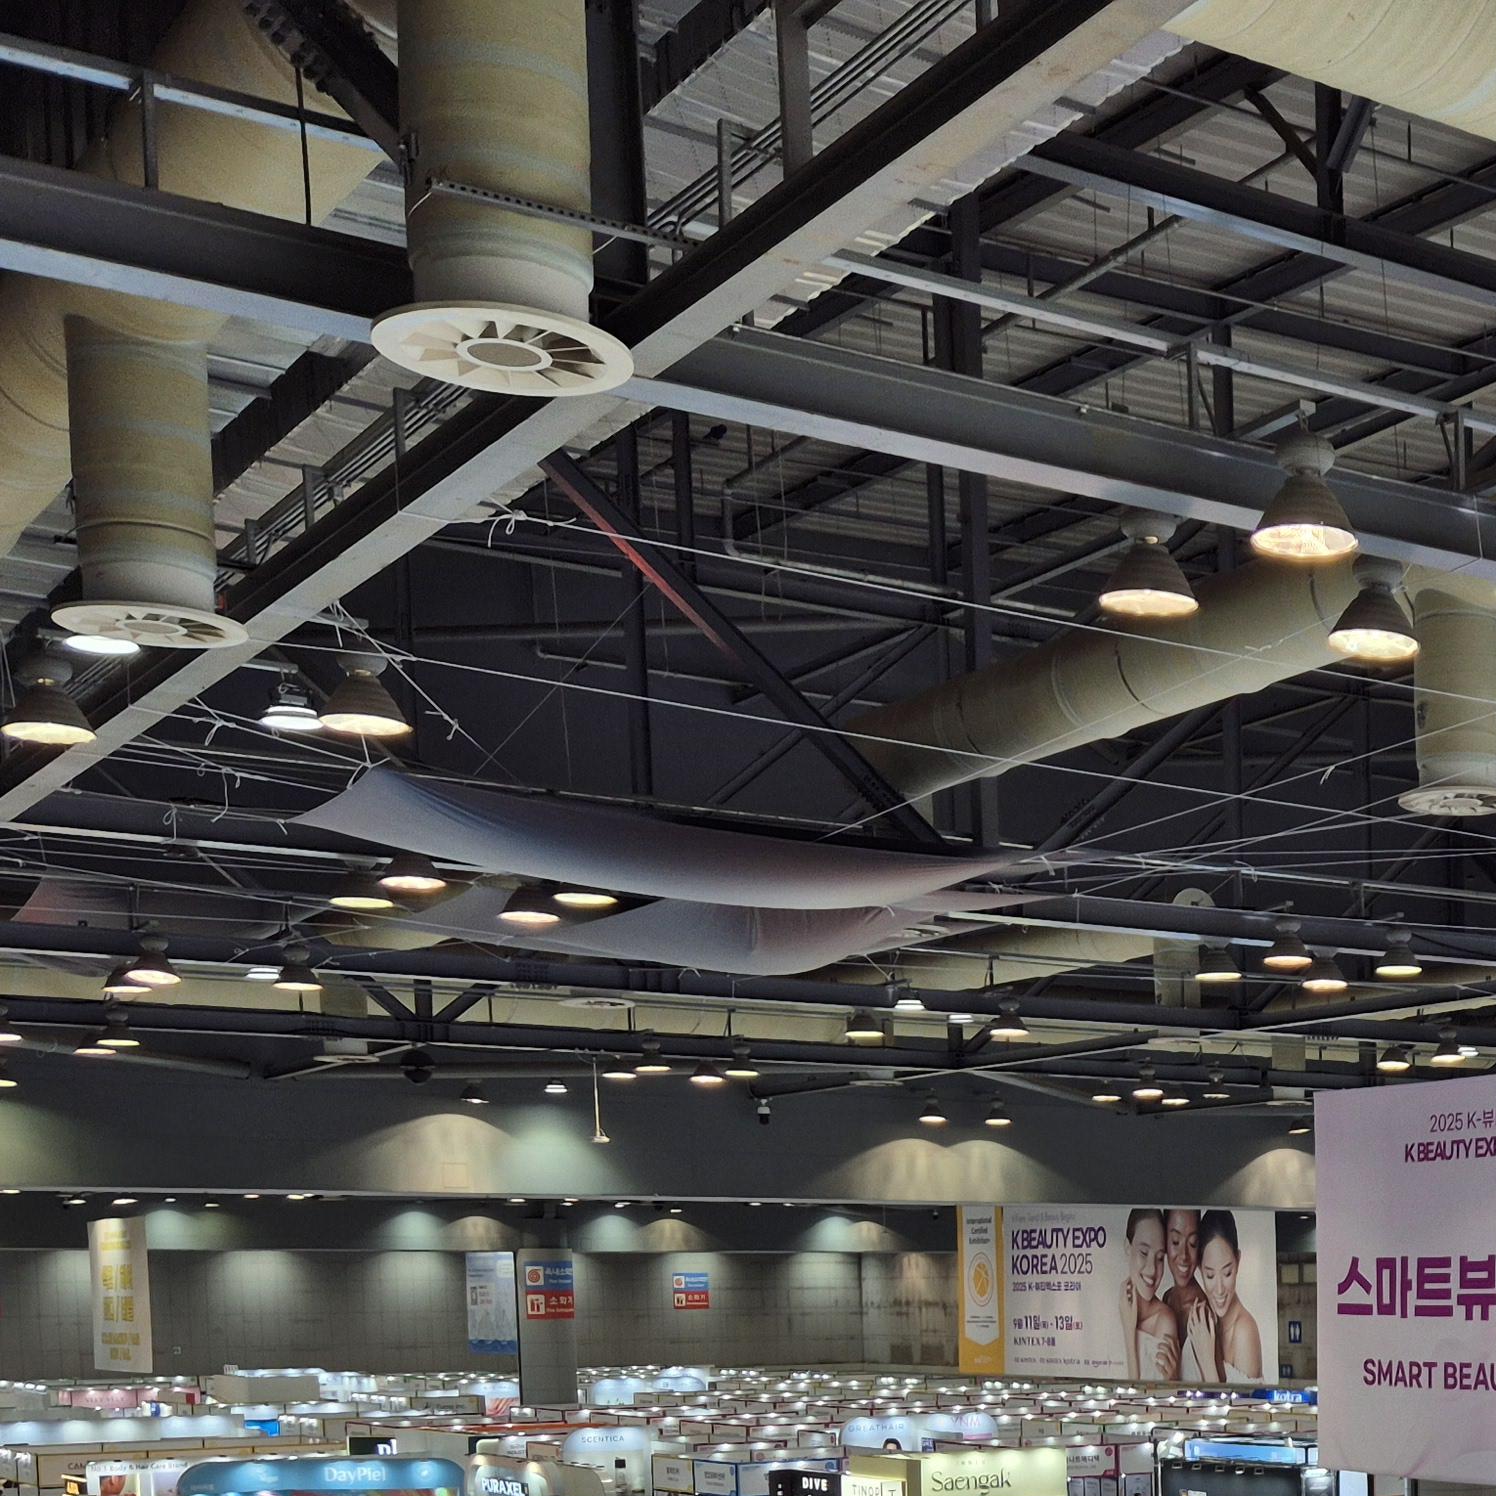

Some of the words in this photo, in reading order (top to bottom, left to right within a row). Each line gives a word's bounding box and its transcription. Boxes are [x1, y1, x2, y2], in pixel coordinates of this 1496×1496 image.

[1430, 1113, 1463, 1132] 2025
[1021, 1228, 1071, 1249] BEAUTY
[1072, 1226, 1106, 1248] EXPO
[1011, 1254, 1058, 1275] KOREA
[1060, 1253, 1093, 1275] 2025
[1363, 1359, 1437, 1389] SMART
[581, 1435, 624, 1443] SCENTICA
[802, 1476, 828, 1492] DIVE
[931, 1469, 1012, 1496] Saengak
